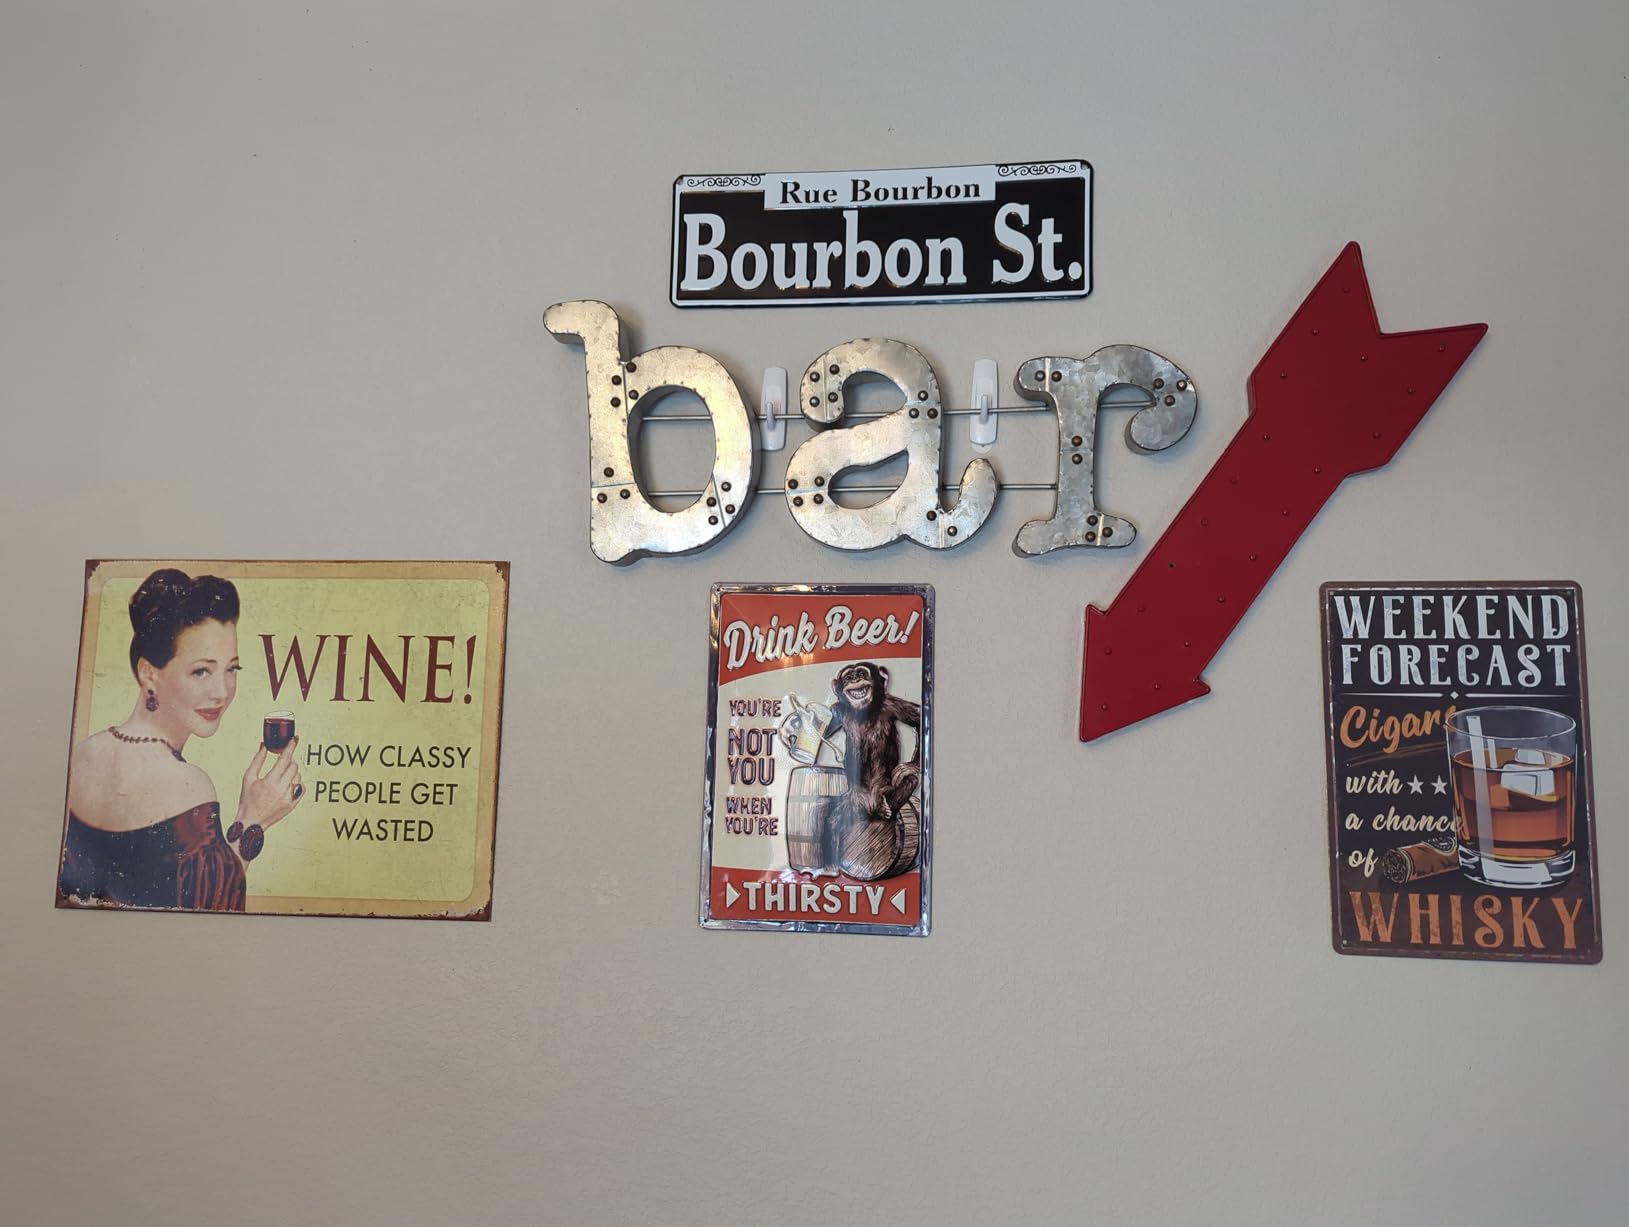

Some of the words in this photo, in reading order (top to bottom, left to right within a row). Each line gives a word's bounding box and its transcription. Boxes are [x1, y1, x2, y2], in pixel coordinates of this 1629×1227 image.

[779, 181, 838, 204] Rue
[850, 176, 981, 203] Bourbon
[680, 209, 967, 291] Bourbon
[991, 203, 1083, 285] St.
[543, 300, 1198, 566] bar
[1333, 594, 1570, 640] WEEKEND
[723, 611, 819, 671] Drink
[824, 605, 920, 649] Beer!
[257, 633, 477, 704] WINE!
[1341, 644, 1571, 688] FORECAST
[728, 698, 782, 718] YOU'RE
[305, 744, 372, 768] HOW
[378, 745, 472, 770] CLASSY
[728, 728, 777, 757] NOT
[727, 757, 775, 786] YOU
[1345, 770, 1404, 795] with
[314, 780, 401, 804] PEOPLE
[410, 782, 459, 806] GET
[726, 797, 773, 815] WHEN
[332, 818, 434, 842] WASTED
[725, 817, 779, 836] YOU'RE
[1344, 812, 1363, 831] a
[1371, 806, 1464, 833] chance
[1348, 848, 1378, 878] of
[743, 882, 885, 915] THIRSTY
[1349, 891, 1584, 949] WHISKY
